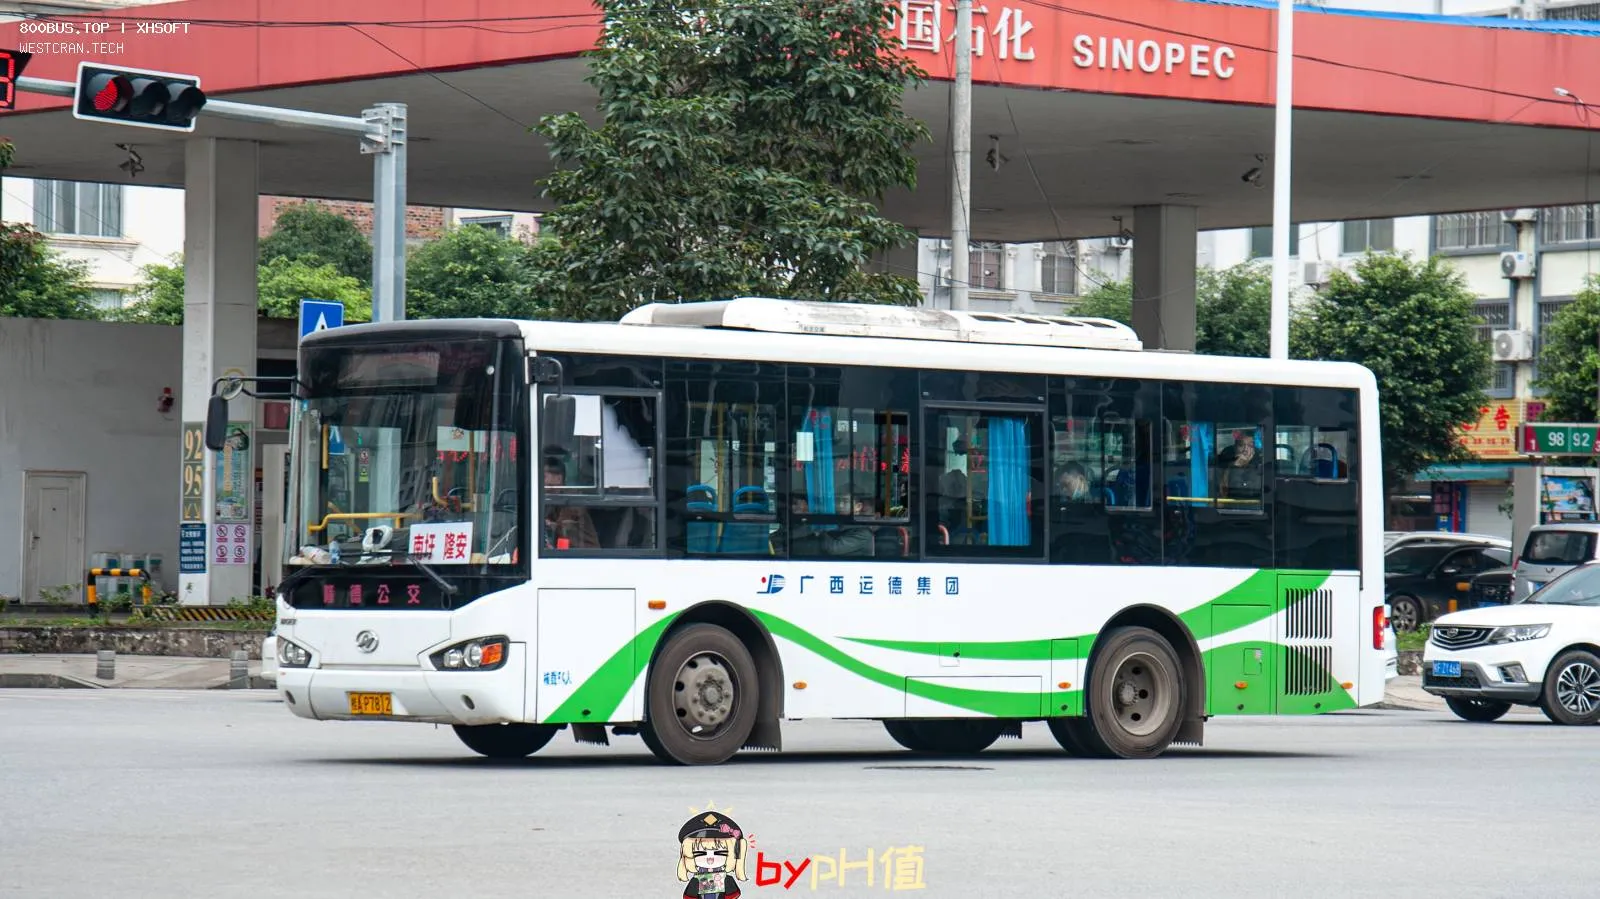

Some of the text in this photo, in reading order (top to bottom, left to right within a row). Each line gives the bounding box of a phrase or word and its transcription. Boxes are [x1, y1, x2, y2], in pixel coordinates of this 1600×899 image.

[874, 0, 1035, 61] 国石化
[1072, 34, 1235, 79] SINOPEC
[184, 429, 203, 461] 92
[1529, 439, 1536, 450] 1
[1548, 431, 1565, 447] 98
[1572, 432, 1590, 447] 92
[184, 464, 203, 496] 95
[443, 531, 467, 560] 隆安
[799, 575, 960, 596] 广西运德集团
